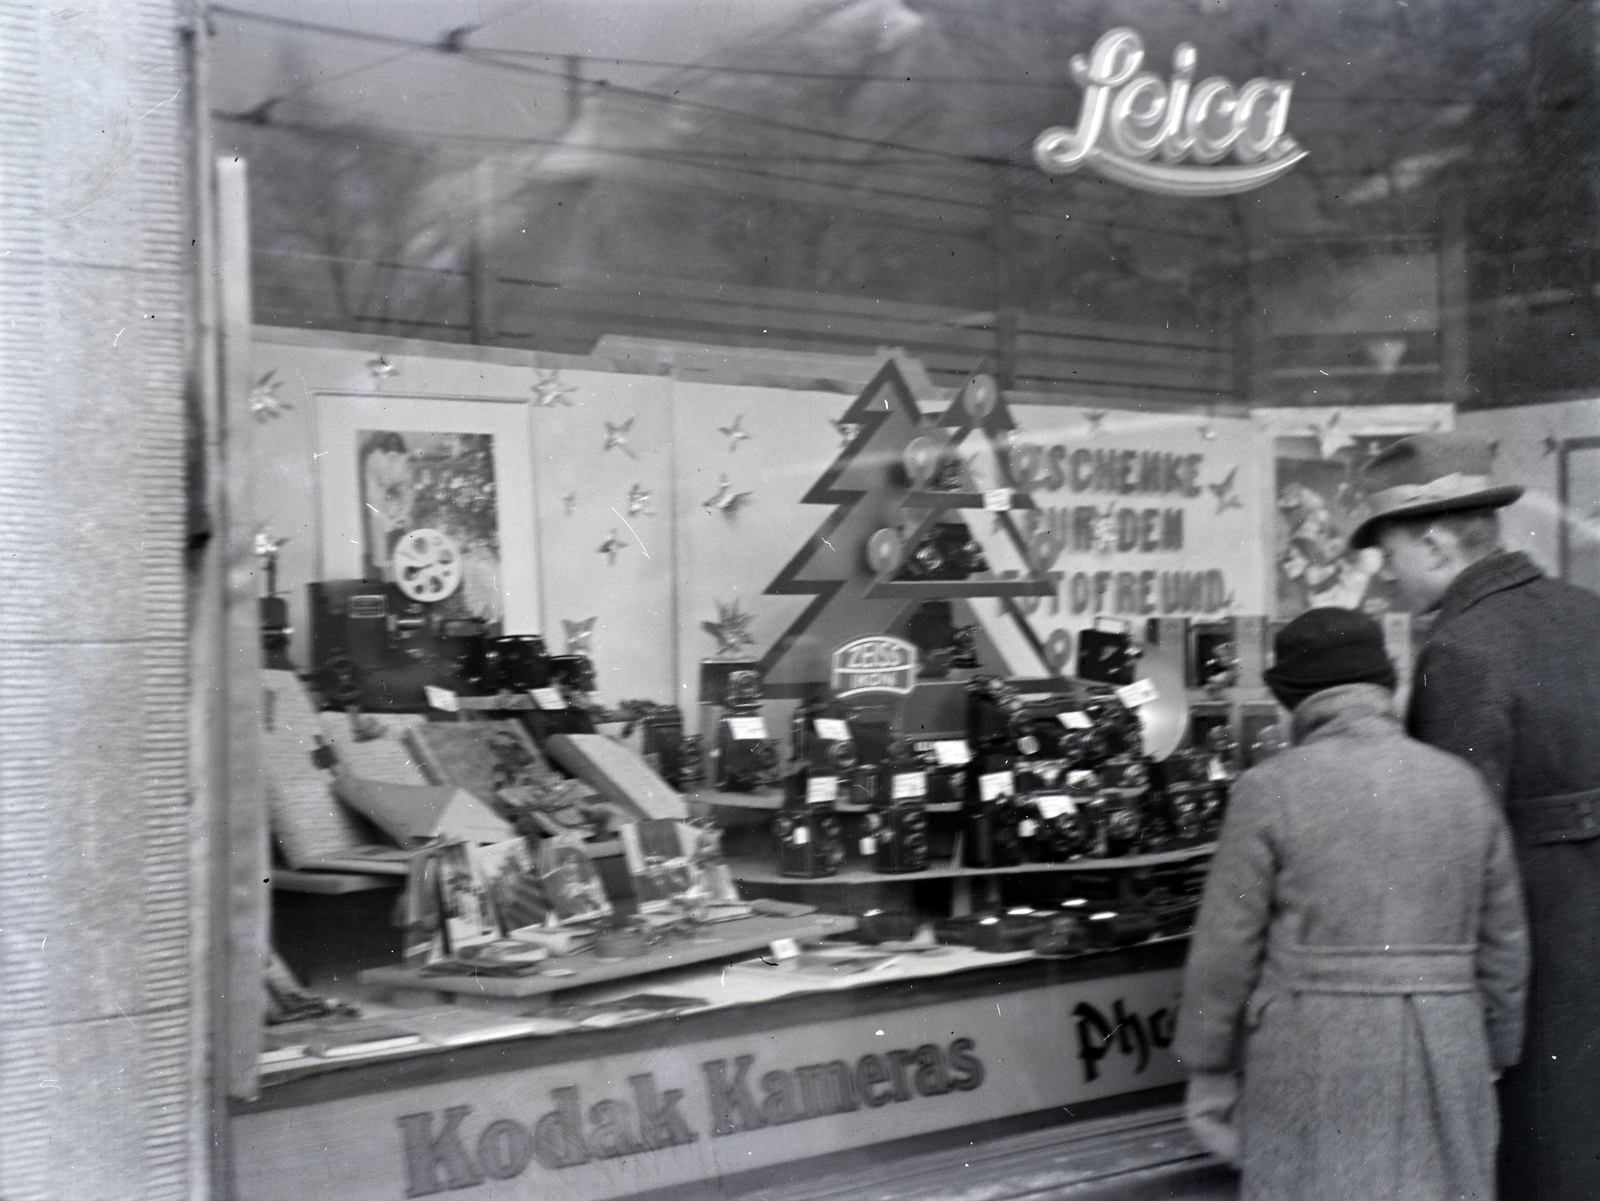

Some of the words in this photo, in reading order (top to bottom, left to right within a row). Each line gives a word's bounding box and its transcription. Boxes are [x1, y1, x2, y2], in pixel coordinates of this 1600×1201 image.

[1033, 26, 1309, 196] Leica
[1002, 445, 1203, 497] SCHENKE
[1116, 507, 1183, 553] DEN
[847, 641, 904, 668] ZEISS
[396, 1073, 699, 1199] Kodak
[701, 1036, 985, 1138] Kameras
